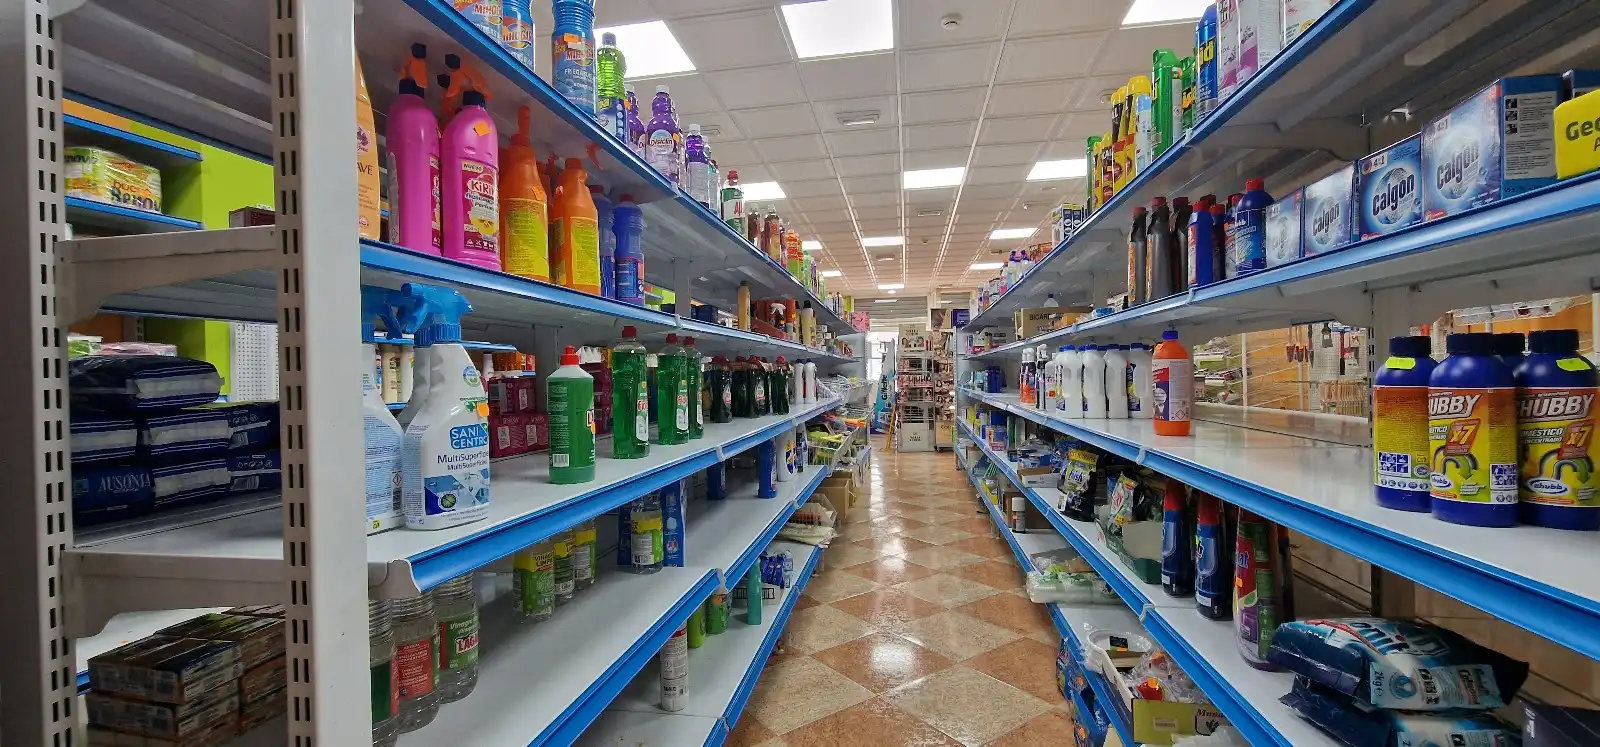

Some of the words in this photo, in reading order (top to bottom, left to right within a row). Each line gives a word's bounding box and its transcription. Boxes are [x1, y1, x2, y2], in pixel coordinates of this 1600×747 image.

[1437, 140, 1479, 190] Calgon
[1373, 173, 1415, 216] Calgon
[1312, 202, 1340, 236] Calgon
[451, 426, 479, 440] SANI
[98, 473, 151, 492] AUSONIA
